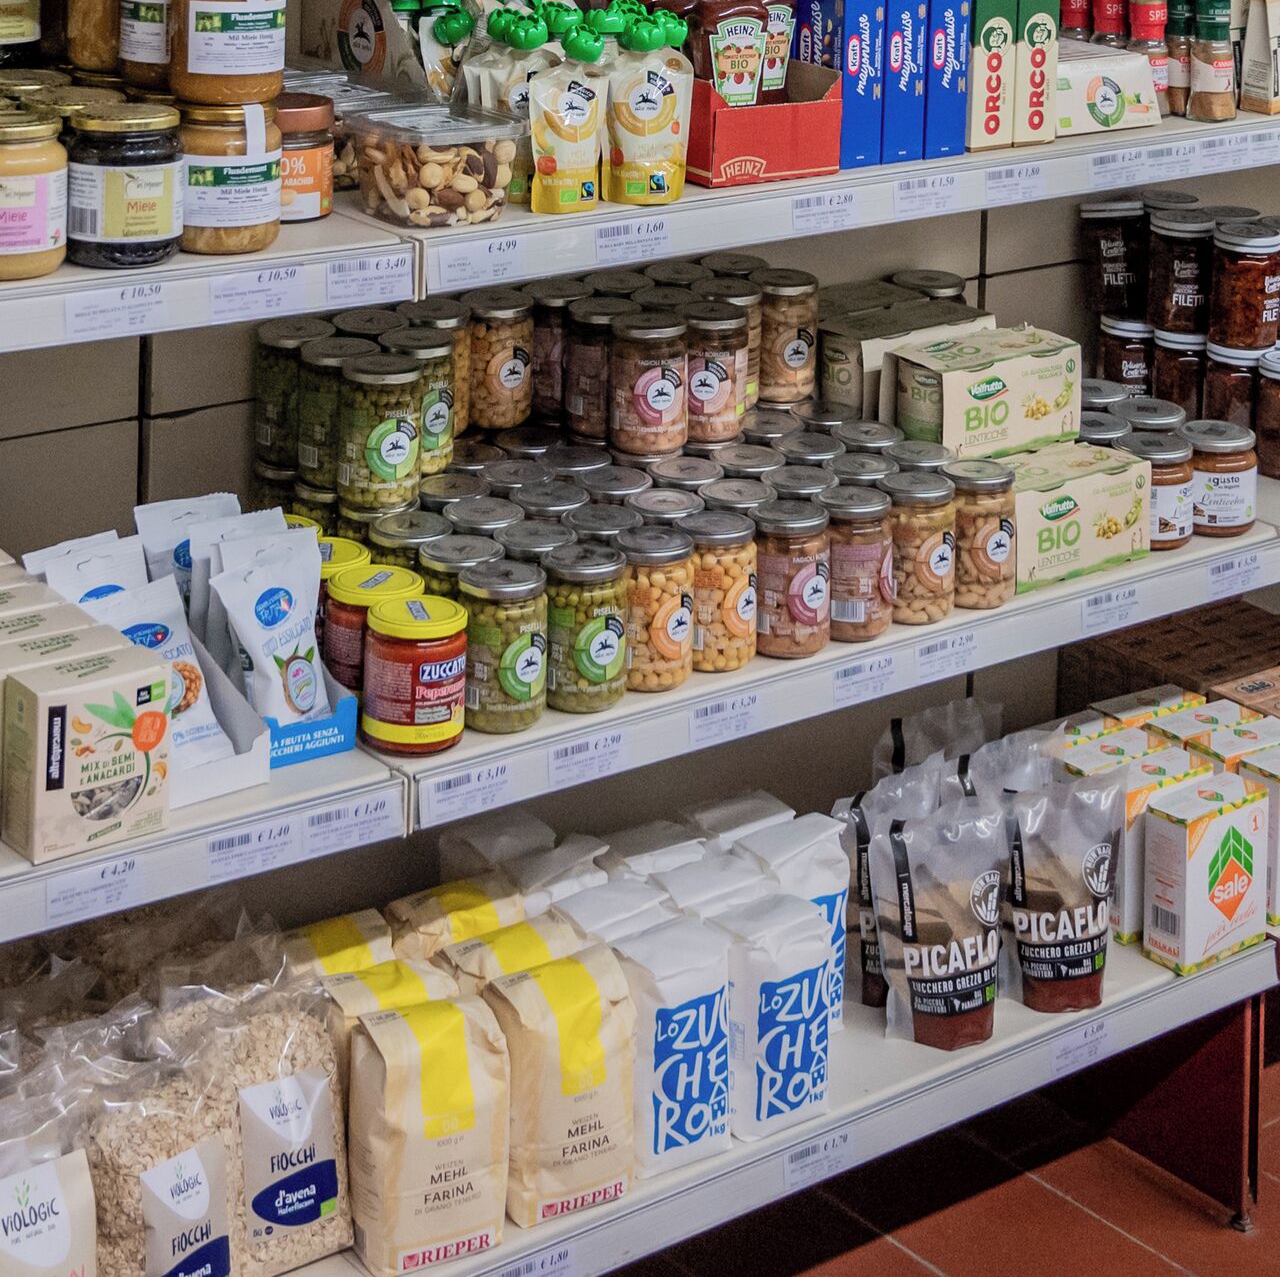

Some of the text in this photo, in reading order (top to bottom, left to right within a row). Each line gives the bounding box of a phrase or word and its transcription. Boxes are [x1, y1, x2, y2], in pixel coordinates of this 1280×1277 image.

[725, 25, 755, 38] HEINZ
[855, 13, 870, 95] mayonnaise
[898, 11, 912, 92] mayonnaise
[941, 8, 954, 89] mayonnaise
[730, 60, 749, 70] BIO
[984, 47, 1002, 136] ORCO
[1028, 47, 1046, 131] ORCO
[725, 161, 763, 178] HEINZ
[127, 200, 157, 213] Miele
[829, 193, 854, 205] € 2,80
[637, 222, 664, 234] € 1,60
[488, 240, 517, 253] € 4,99
[376, 257, 407, 269] € 3,40
[258, 267, 297, 283] € 10,50
[121, 283, 162, 298] € 10,50
[964, 400, 1009, 431] BIO
[964, 428, 1008, 446] LENTICCHIE
[1036, 522, 1081, 553] BIO
[1038, 550, 1080, 569] LENTICCHIE
[281, 728, 339, 748] FRUTTA SENZA
[81, 761, 100, 773] MIX
[112, 752, 135, 765] SEMI
[477, 766, 506, 783] € 3,10
[1212, 871, 1250, 908] sale
[567, 1119, 604, 1139] MEHL
[562, 1134, 610, 1158] FARINA
[429, 1166, 469, 1185] MEHL
[275, 1183, 317, 1207] d'avena
[423, 1182, 474, 1205] FARINA
[560, 1182, 623, 1215] RIEPER
[420, 1233, 491, 1266] RIEPER
